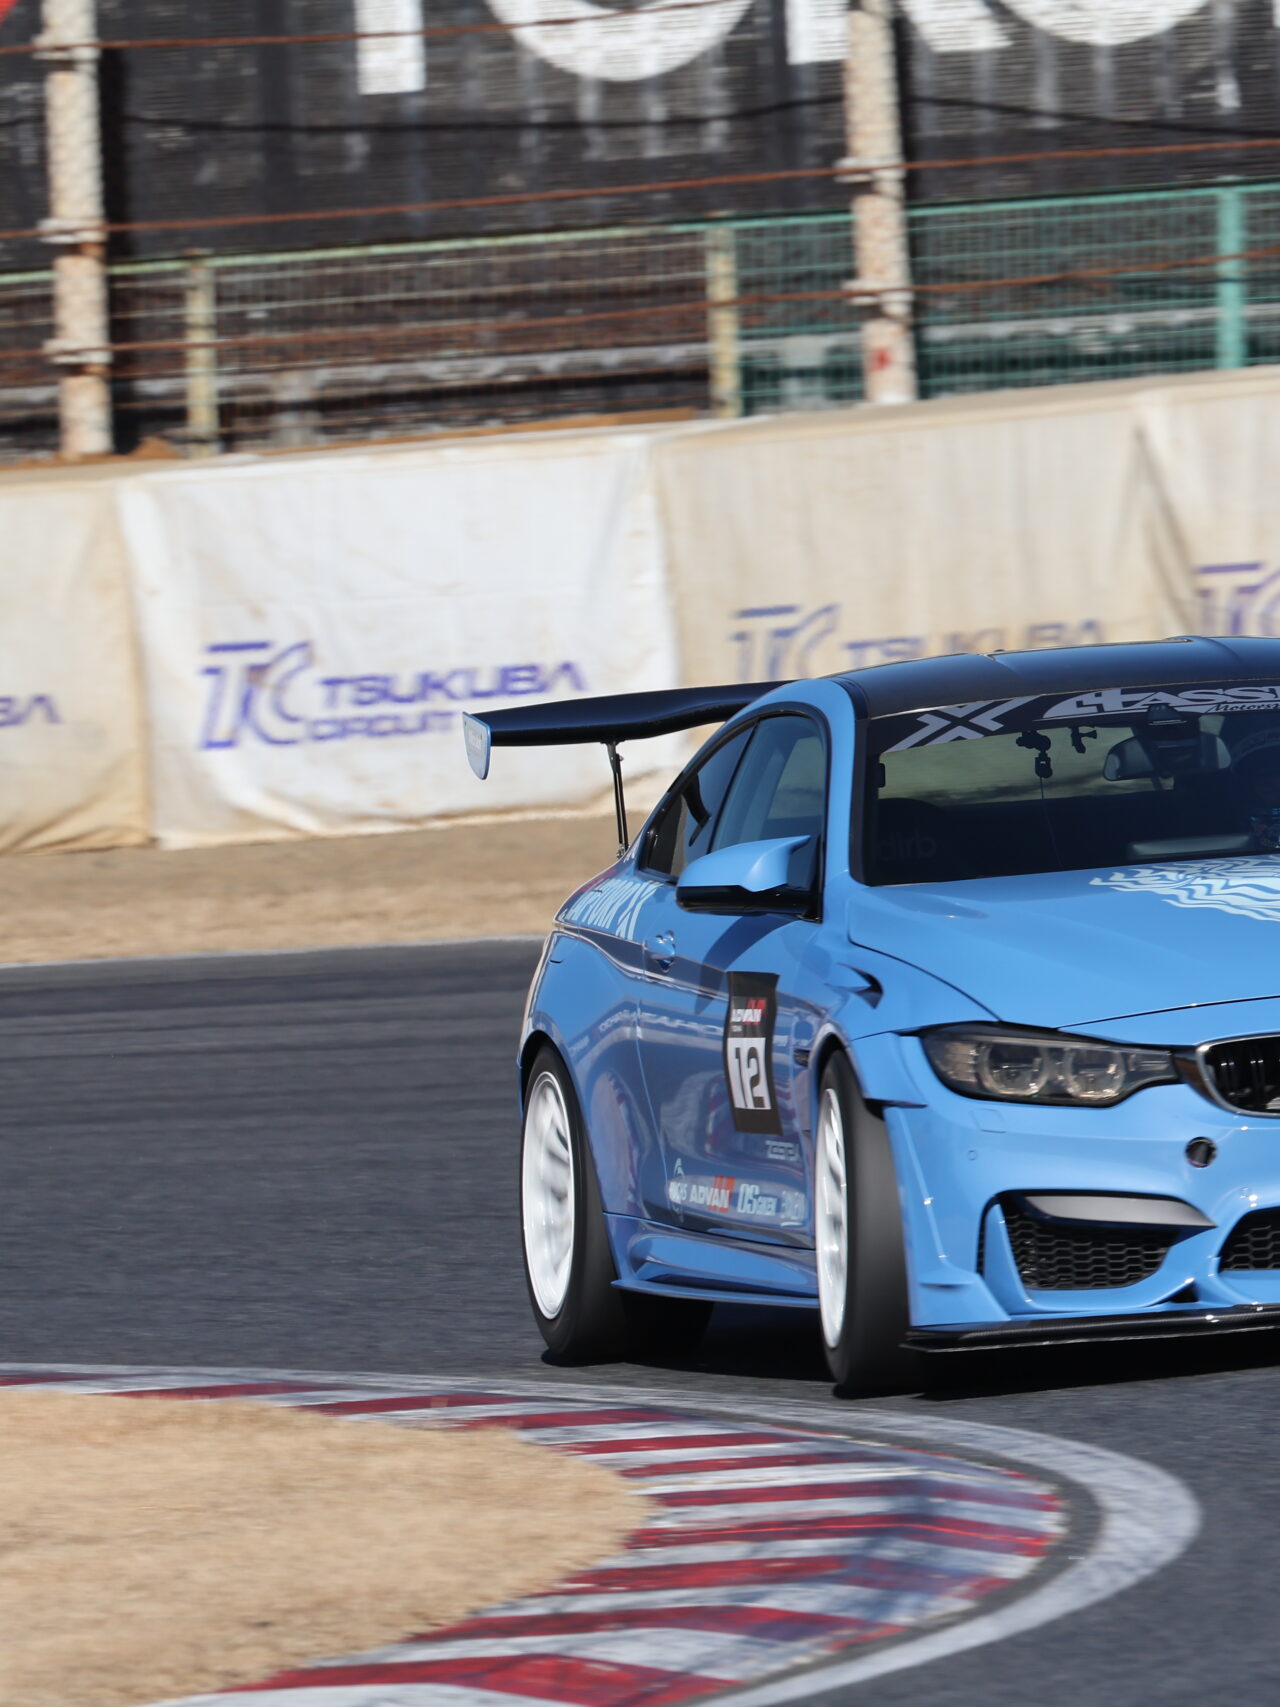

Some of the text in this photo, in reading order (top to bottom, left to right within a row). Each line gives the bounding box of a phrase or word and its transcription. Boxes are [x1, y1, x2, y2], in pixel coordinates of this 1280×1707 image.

[319, 660, 587, 709] TSUKUBA
[734, 1045, 767, 1109] 12
[689, 1184, 731, 1209] ADVAN
